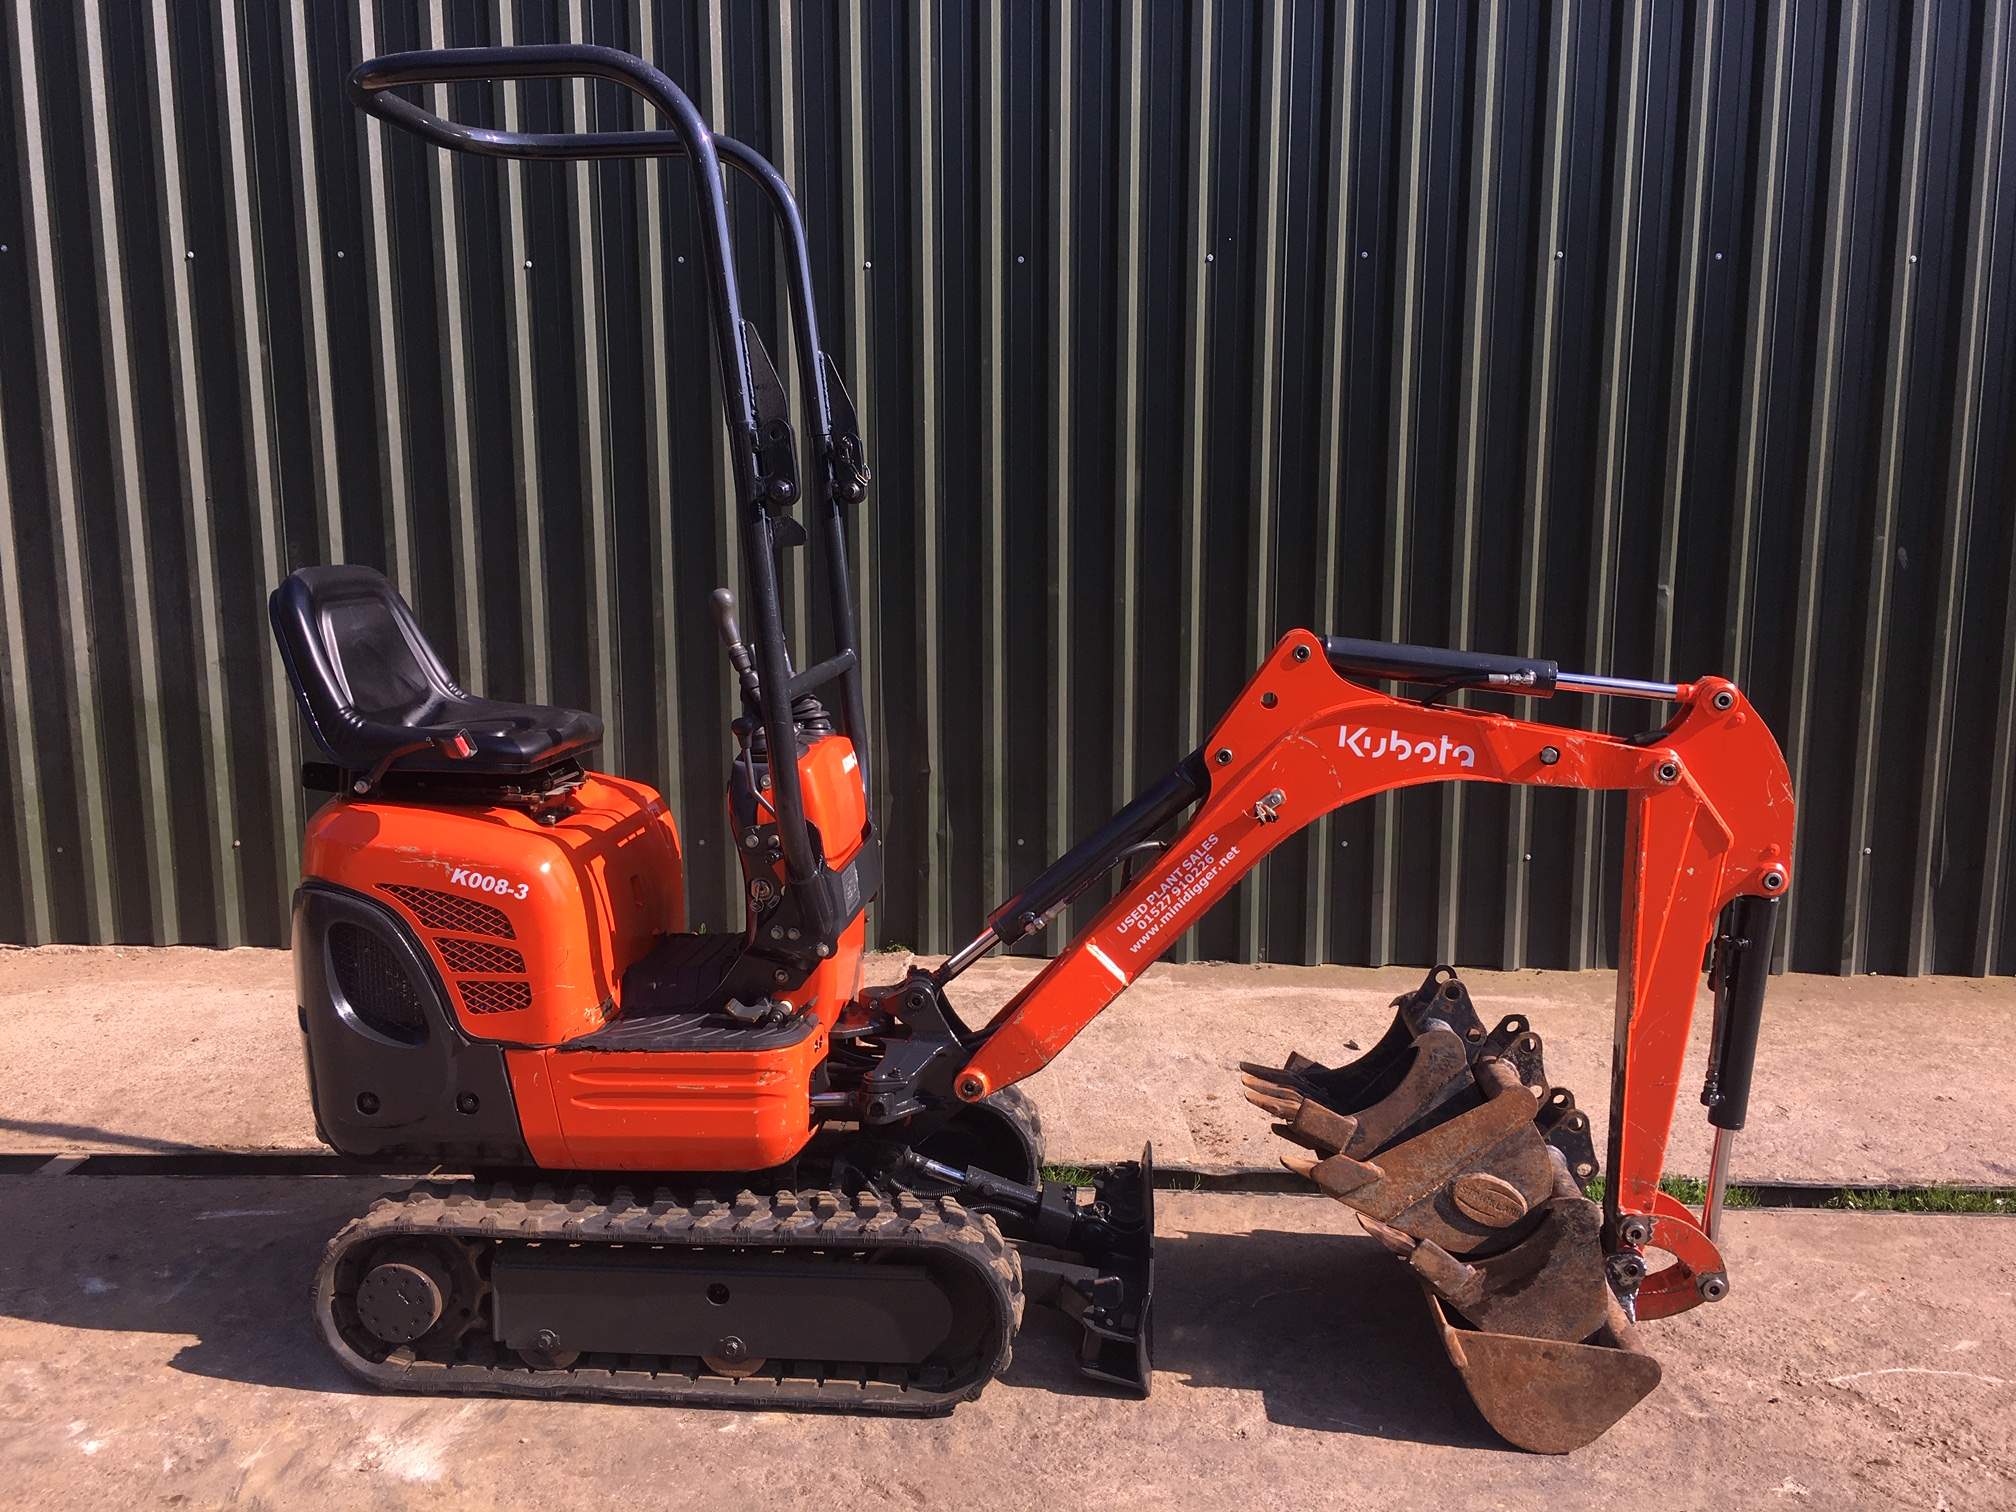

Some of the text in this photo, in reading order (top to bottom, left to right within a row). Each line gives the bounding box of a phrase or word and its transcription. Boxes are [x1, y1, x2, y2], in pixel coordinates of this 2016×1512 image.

[1338, 725, 1475, 768] Kubota
[450, 867, 529, 900] K008-3
[1116, 833, 1219, 934] USED PLANT SALES
[1129, 845, 1241, 953] www.minidigger.net
[1137, 854, 1215, 930] 01527 910226
